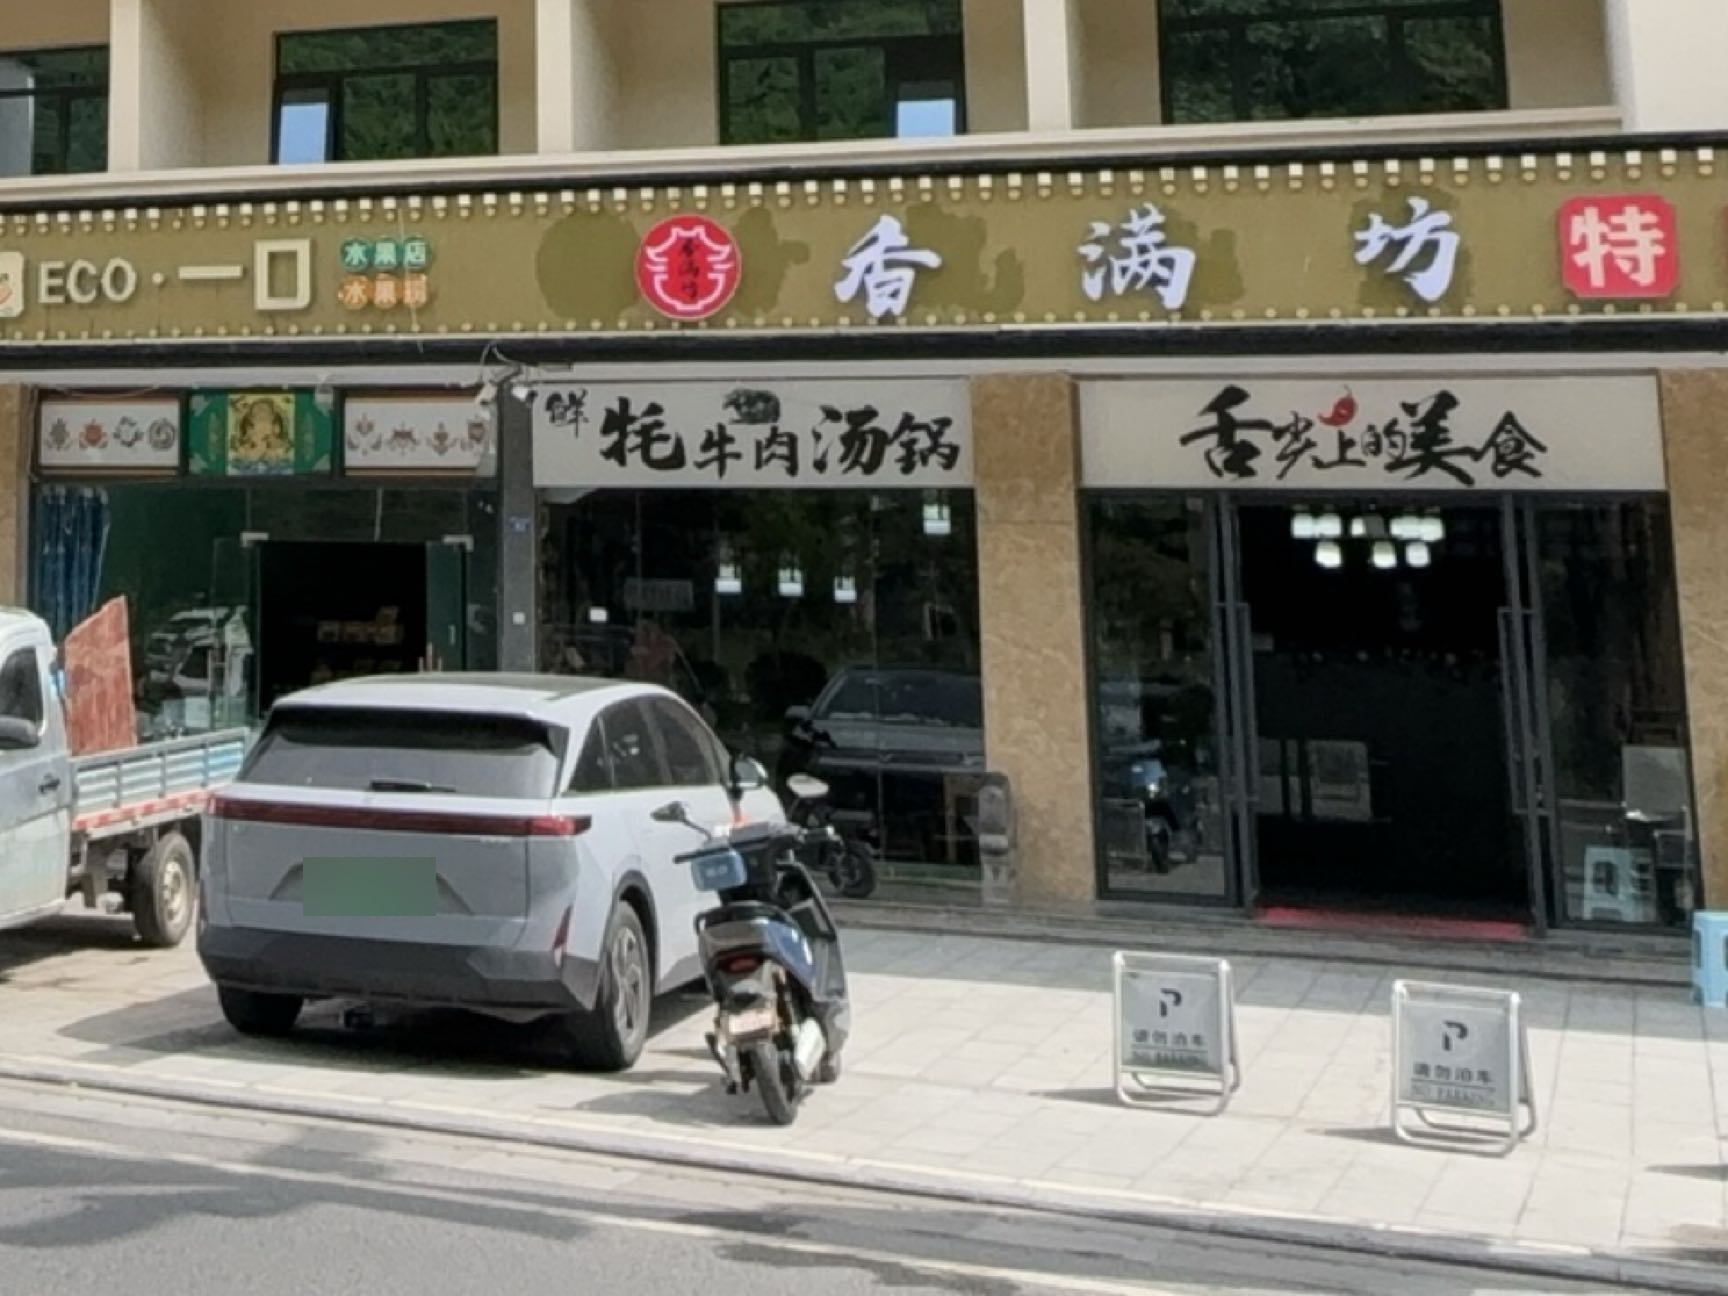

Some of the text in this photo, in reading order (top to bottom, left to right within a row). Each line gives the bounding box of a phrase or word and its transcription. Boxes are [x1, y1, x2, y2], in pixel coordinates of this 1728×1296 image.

[342, 240, 427, 266] 水果店
[835, 195, 1460, 318] 香满坊
[1570, 205, 1665, 288] 特
[1180, 384, 1547, 487] 舌尖上的美食
